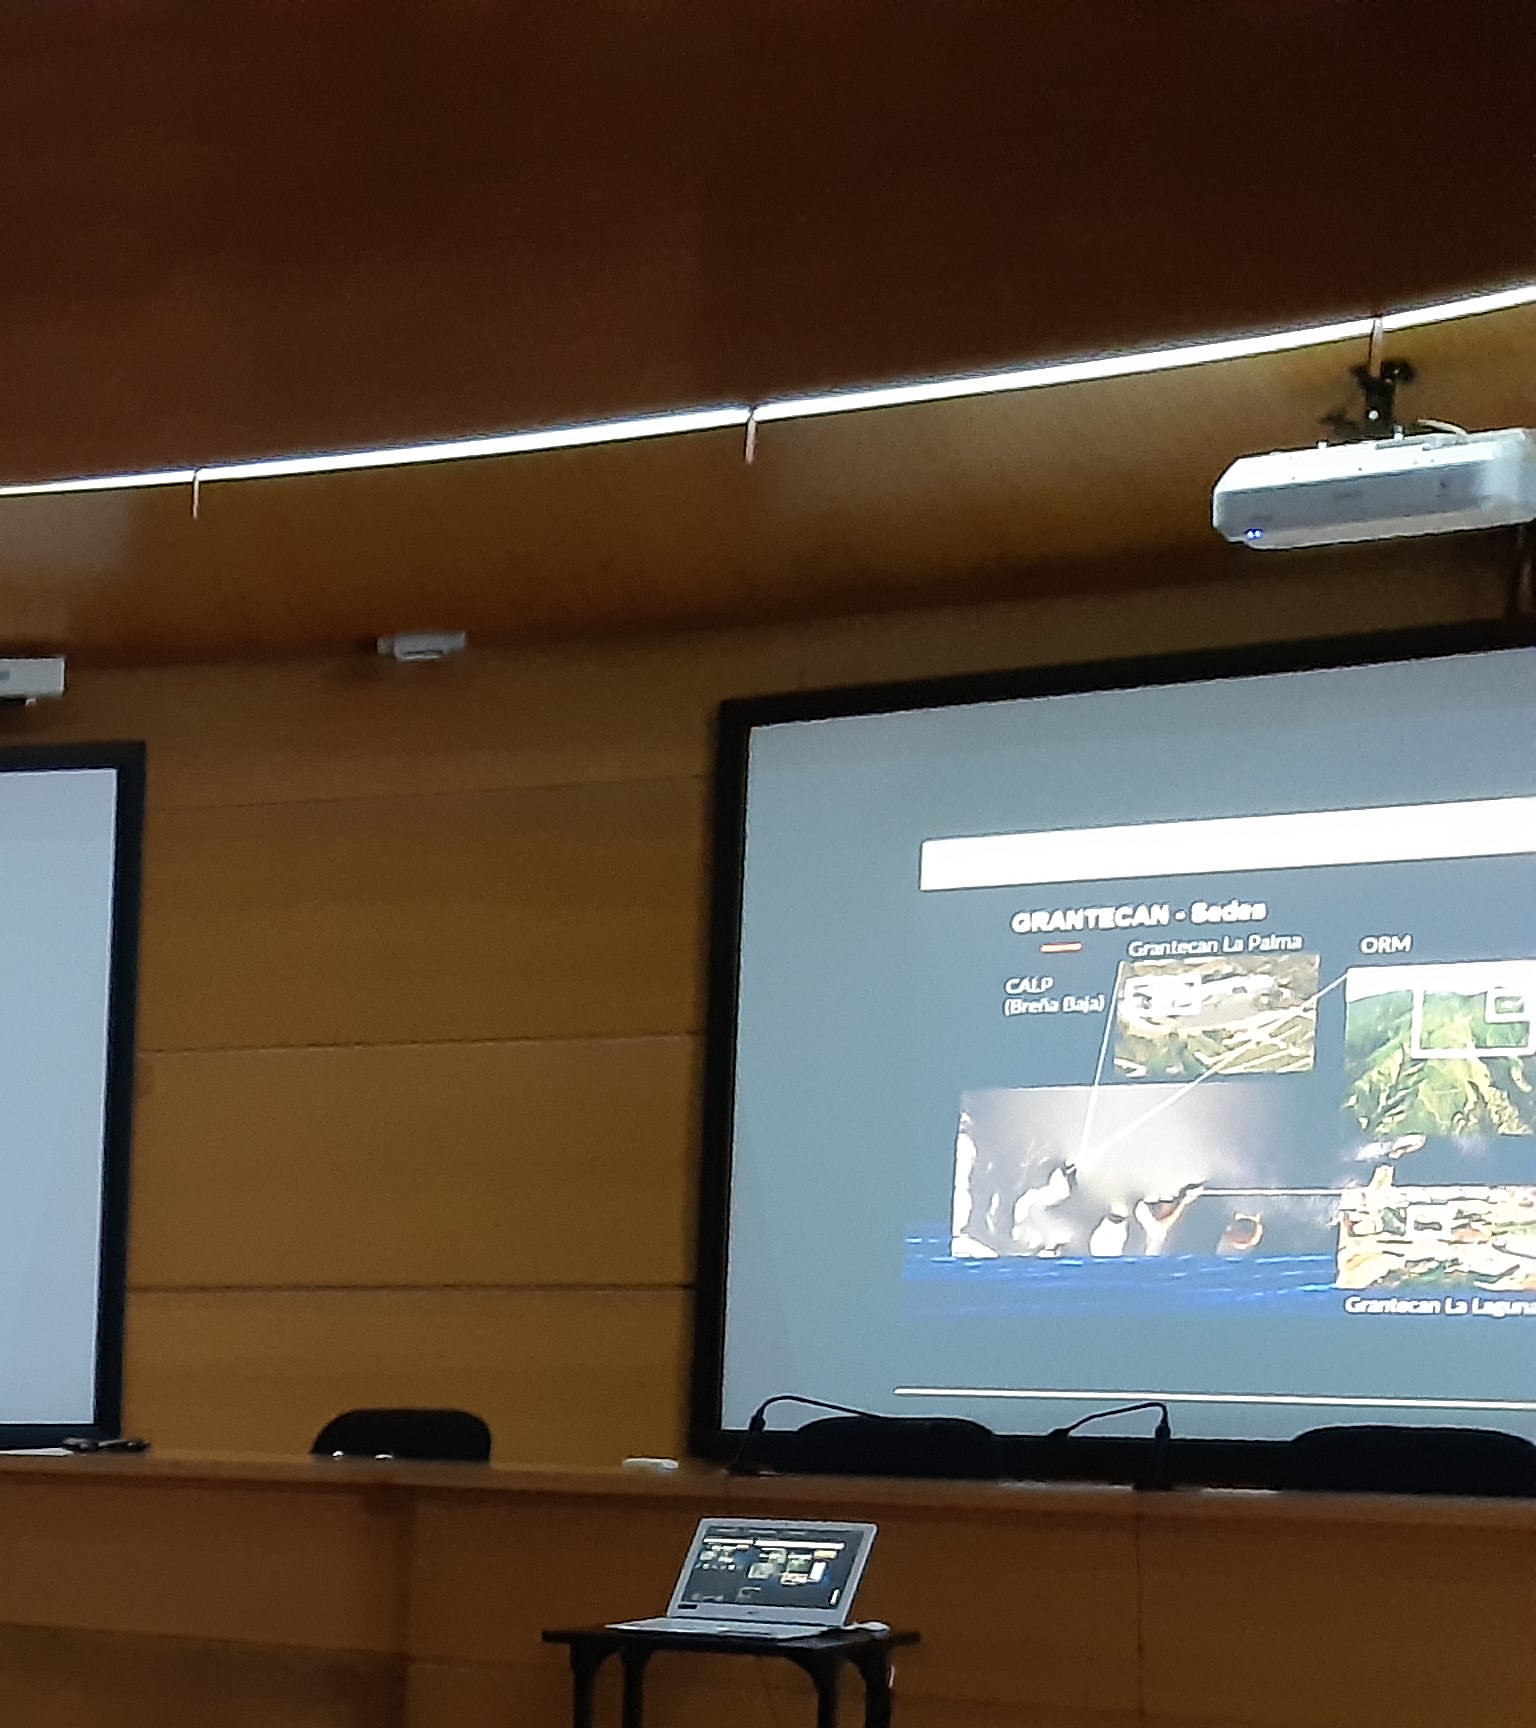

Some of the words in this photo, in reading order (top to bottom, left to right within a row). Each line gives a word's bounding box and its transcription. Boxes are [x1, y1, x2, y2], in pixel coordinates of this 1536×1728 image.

[1010, 904, 1170, 934] GRANTECAN
[1190, 900, 1268, 924] Sedes
[1127, 940, 1218, 957] Grantecan
[1223, 936, 1244, 952] La
[1247, 933, 1304, 952] Palma
[1360, 934, 1412, 954] ORM
[1005, 976, 1054, 995] CALP
[1344, 1296, 1441, 1314] Grantecan
[1444, 1297, 1468, 1315] La
